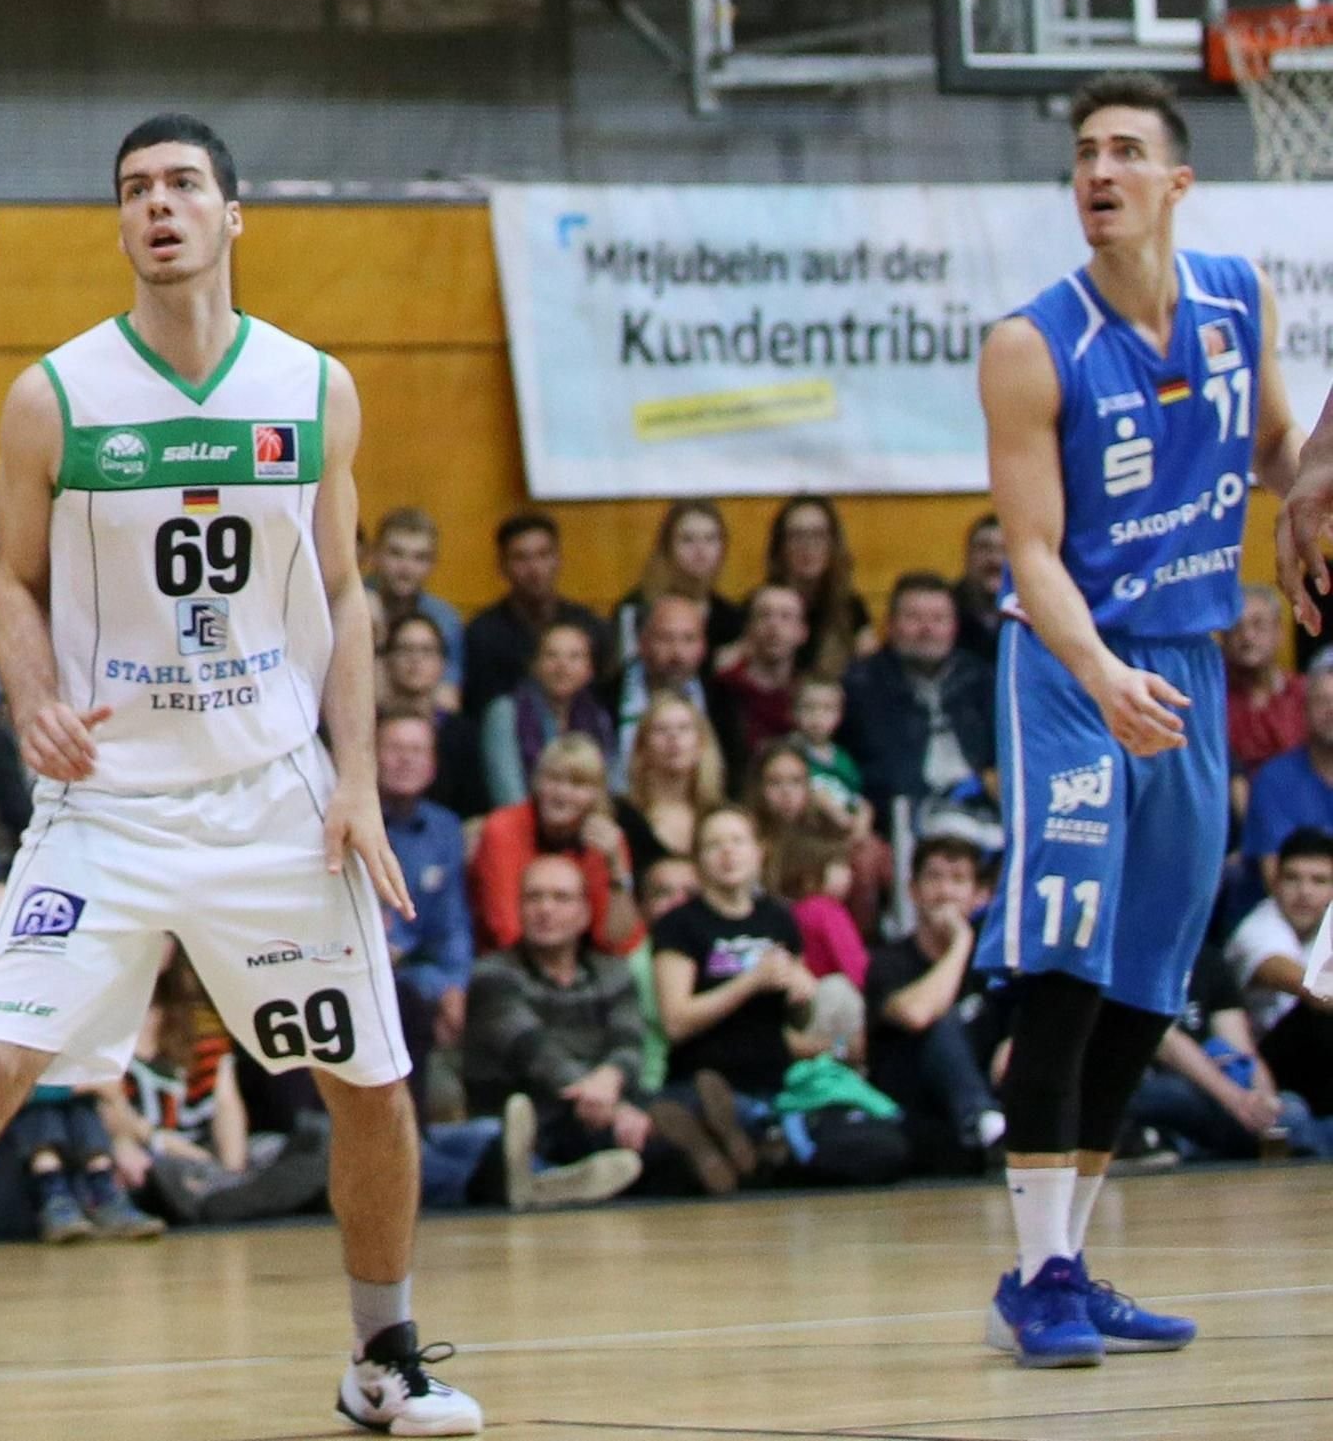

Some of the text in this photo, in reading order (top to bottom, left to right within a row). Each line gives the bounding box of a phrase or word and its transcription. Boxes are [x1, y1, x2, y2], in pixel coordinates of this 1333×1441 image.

[585, 240, 951, 299] Mitjubeln auf der
[1203, 368, 1252, 444] 11
[161, 442, 238, 462] saller
[155, 516, 252, 597] 69
[106, 659, 192, 685] STAHL
[151, 686, 254, 712] LEIPZIG
[1035, 875, 1100, 948] 11
[253, 988, 355, 1064] 69
